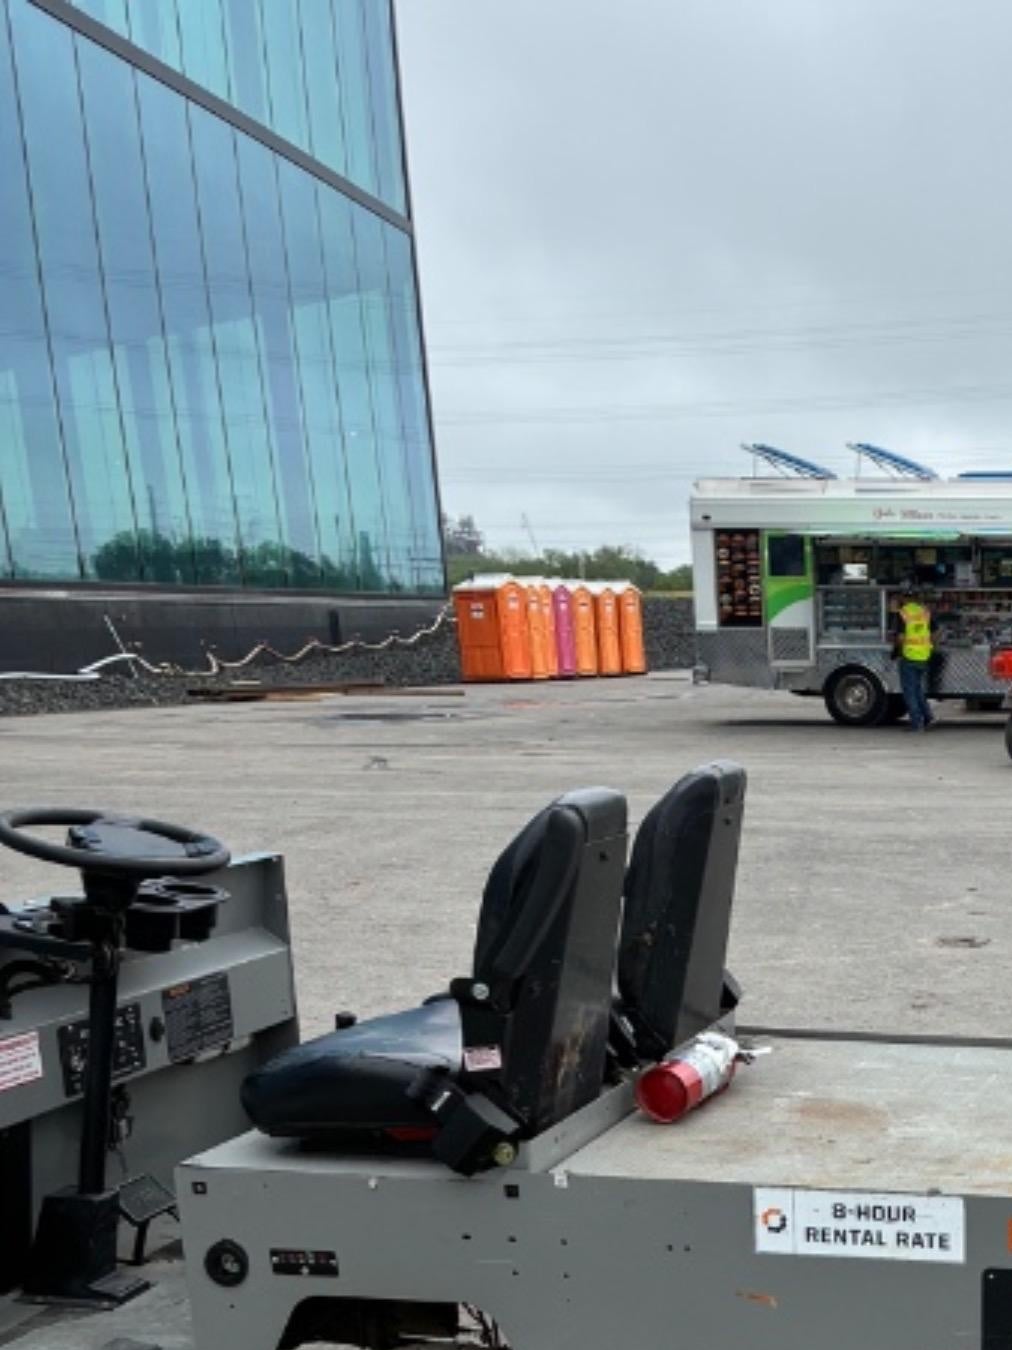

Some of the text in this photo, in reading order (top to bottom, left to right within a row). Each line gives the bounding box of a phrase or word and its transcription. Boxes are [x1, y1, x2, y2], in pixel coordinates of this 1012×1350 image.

[832, 1202, 916, 1223] 8-HOUR
[805, 1226, 951, 1250] RENTAL RATE
